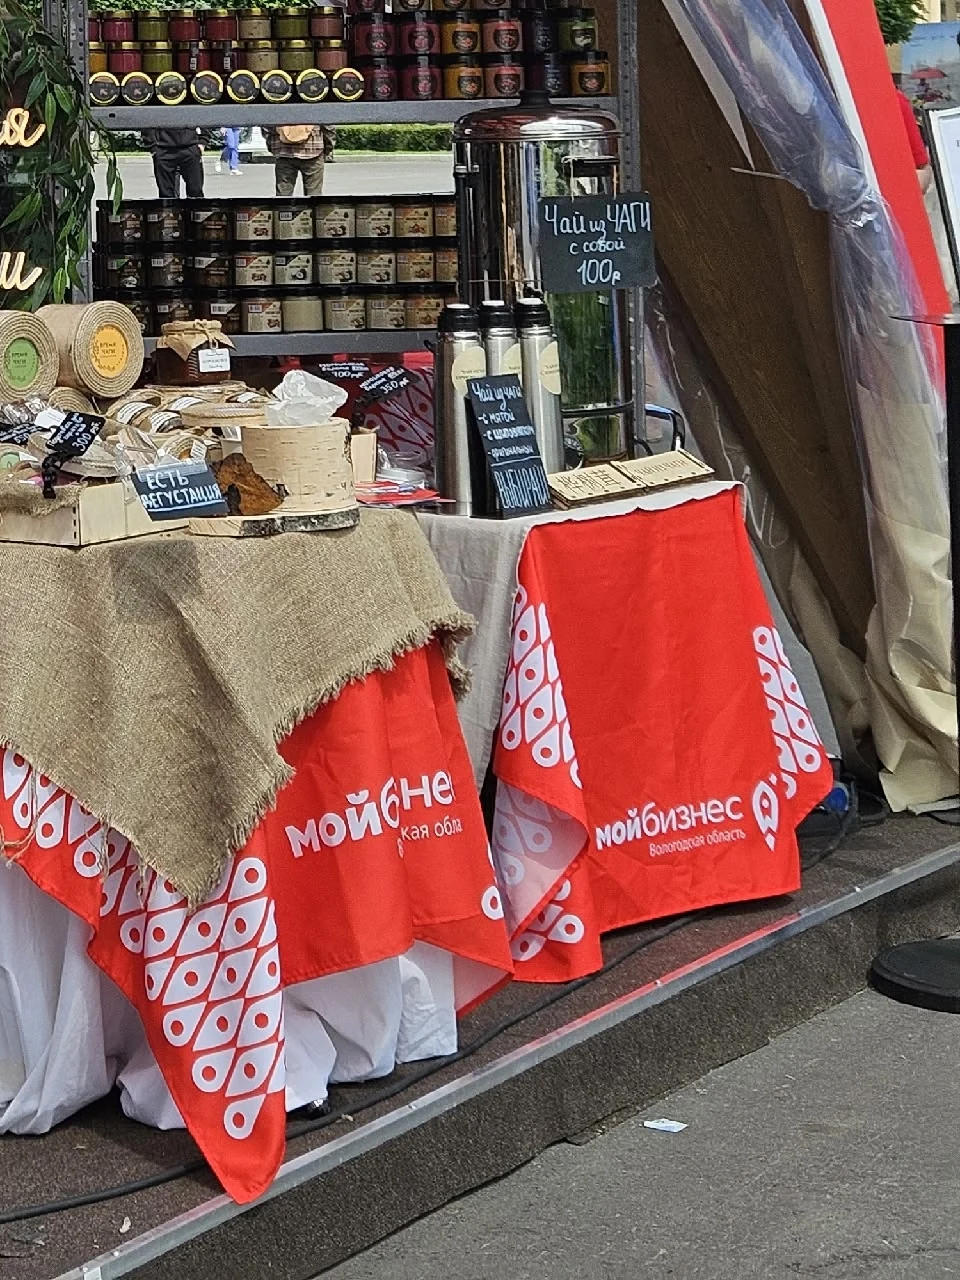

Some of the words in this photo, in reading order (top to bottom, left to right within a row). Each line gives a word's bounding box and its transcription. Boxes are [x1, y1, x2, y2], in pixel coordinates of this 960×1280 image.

[544, 204, 587, 237] Чай
[589, 219, 607, 241] из
[569, 242, 579, 255] с
[583, 237, 626, 253] собой
[471, 381, 495, 403] Чай
[146, 469, 190, 490] ЕСТЬ
[140, 482, 222, 509] ДЕГУСТАЦИЯ
[649, 834, 706, 858] Вологодская
[706, 828, 746, 846] область
